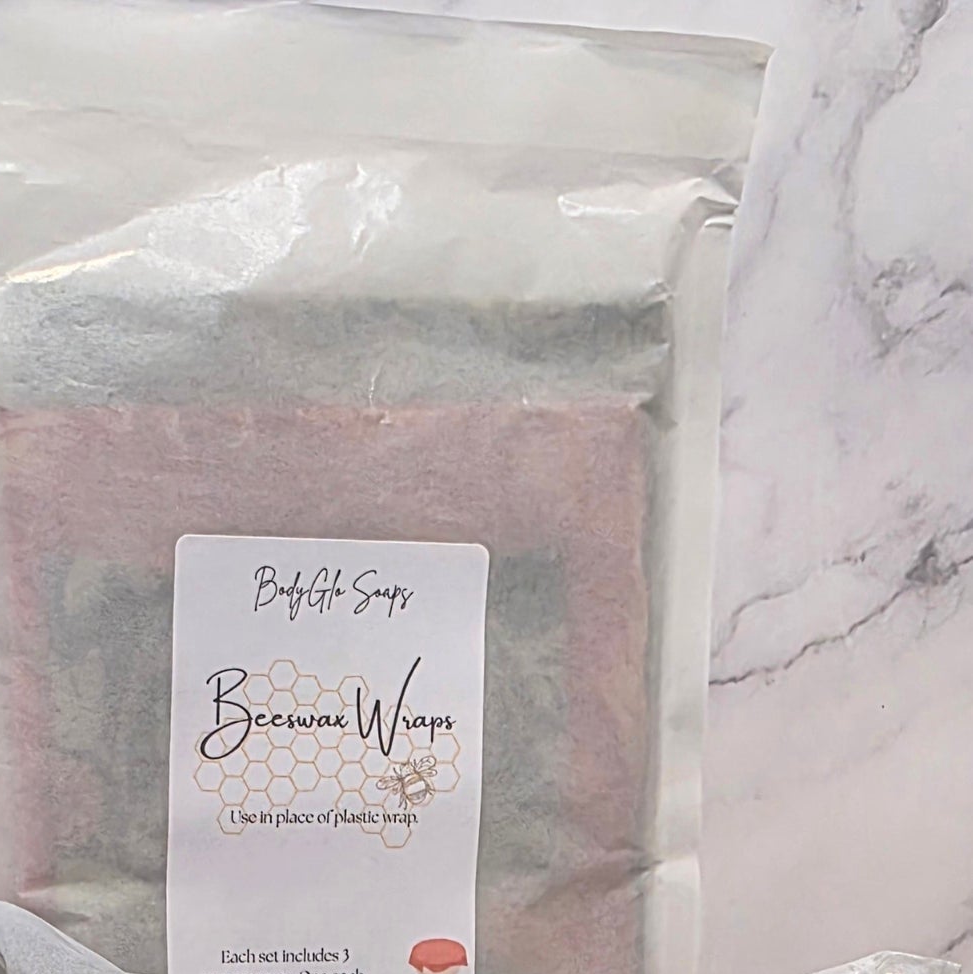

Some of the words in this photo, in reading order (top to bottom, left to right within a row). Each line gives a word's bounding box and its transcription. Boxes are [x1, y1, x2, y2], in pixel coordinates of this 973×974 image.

[352, 569, 414, 618] Soaps
[200, 668, 349, 759] Beeswax
[356, 656, 457, 756] Wraps
[230, 808, 257, 825] Use
[260, 810, 272, 824] in
[276, 809, 314, 828] place
[317, 809, 334, 824] of
[334, 810, 379, 829] plastic
[382, 812, 419, 829] wrap.
[221, 949, 256, 964] Each
[258, 951, 278, 964] set
[282, 947, 339, 964] includes
[342, 949, 350, 964] 3
